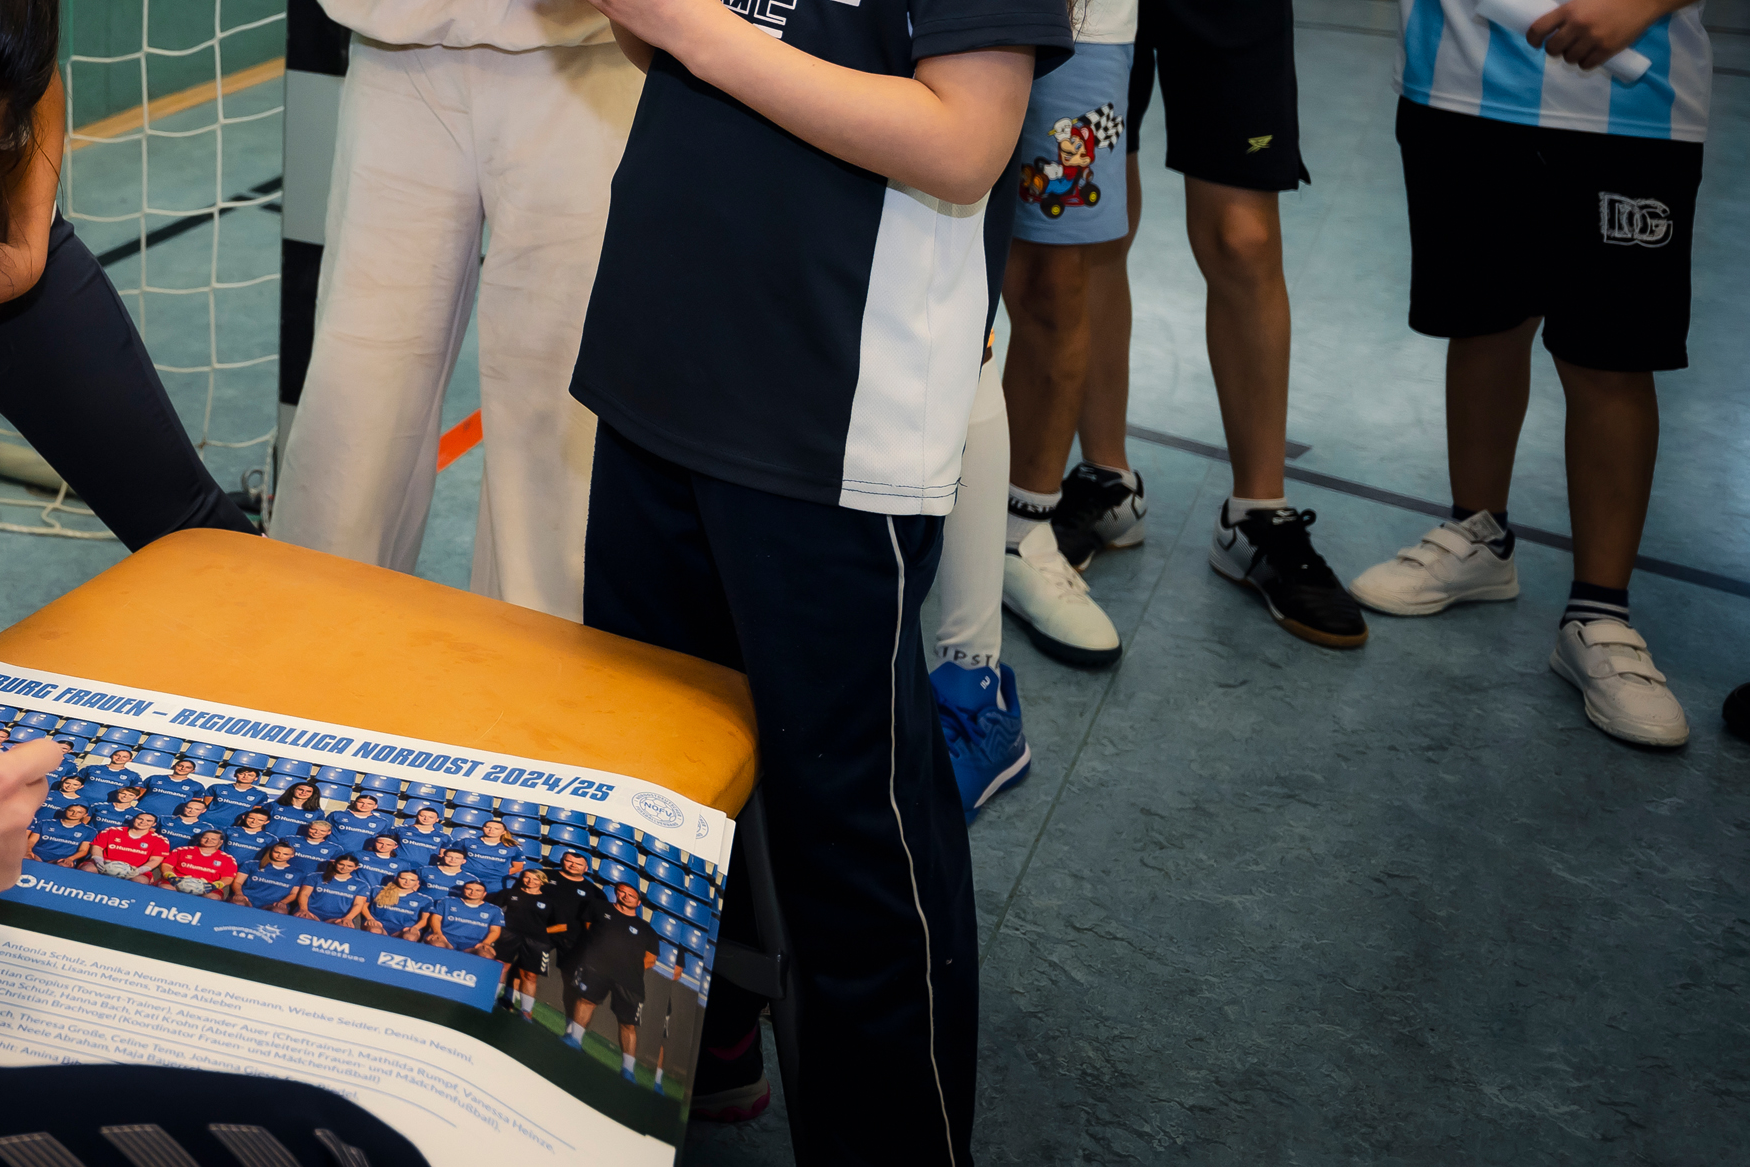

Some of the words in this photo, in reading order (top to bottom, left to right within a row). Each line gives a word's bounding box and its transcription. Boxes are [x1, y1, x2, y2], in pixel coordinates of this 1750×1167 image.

[53, 687, 154, 717] FRAUEN
[169, 708, 355, 754] REGIONALLIGA
[352, 741, 485, 778] NORDOST
[481, 765, 615, 802] 2024/25
[644, 801, 672, 817] NOFV
[36, 879, 132, 909] Humanas
[144, 902, 202, 926] intel
[296, 933, 350, 954] SWM
[312, 947, 366, 963] MAGDEBURG
[377, 951, 478, 984] 24volt.de
[2, 941, 47, 956] Antonia
[49, 951, 88, 967] Schulz,
[90, 961, 131, 976] Annika
[133, 971, 191, 991] Neumann,
[194, 985, 222, 997] Lena
[224, 991, 284, 1012] Neumann,
[288, 1006, 334, 1022] Wiebke
[337, 1017, 381, 1034] Seidler,
[384, 1028, 426, 1045] Denisa
[429, 1039, 474, 1065] Nesimi,
[61, 964, 98, 978] Lisann
[100, 973, 151, 991] Mertens,
[155, 985, 188, 998] Tabea
[190, 994, 242, 1011] Alsleben
[17, 1024, 52, 1037] Neele
[53, 1033, 111, 1053] Abraham,
[114, 1046, 144, 1060] Maja
[18, 982, 57, 998] Schulz,
[59, 992, 98, 1006] Hanna
[100, 1001, 131, 1015] Bach,
[134, 1009, 159, 1021] Kati
[161, 1015, 199, 1030] Krohn
[201, 1024, 314, 1057] (Abteilungsleiterin
[368, 1064, 393, 1077] und
[19, 1013, 65, 1030] Theresa
[110, 1035, 149, 1049] Celine
[189, 1052, 240, 1072] Johanna
[51, 1000, 116, 1021] Brachvogel
[118, 1014, 196, 1039] (Koordinator
[197, 1034, 245, 1050] Frauen-
[247, 1046, 271, 1057] und
[20, 1047, 59, 1062] Amina
[25, 974, 69, 990] Gropius
[71, 984, 173, 1015] (Torwart-Trainer),
[175, 1009, 238, 1029] Alexander
[240, 1024, 270, 1037] Auer
[272, 1031, 354, 1057] (Cheftrainer),
[357, 1051, 414, 1073] Mathilda
[463, 1088, 510, 1124] Vanessa
